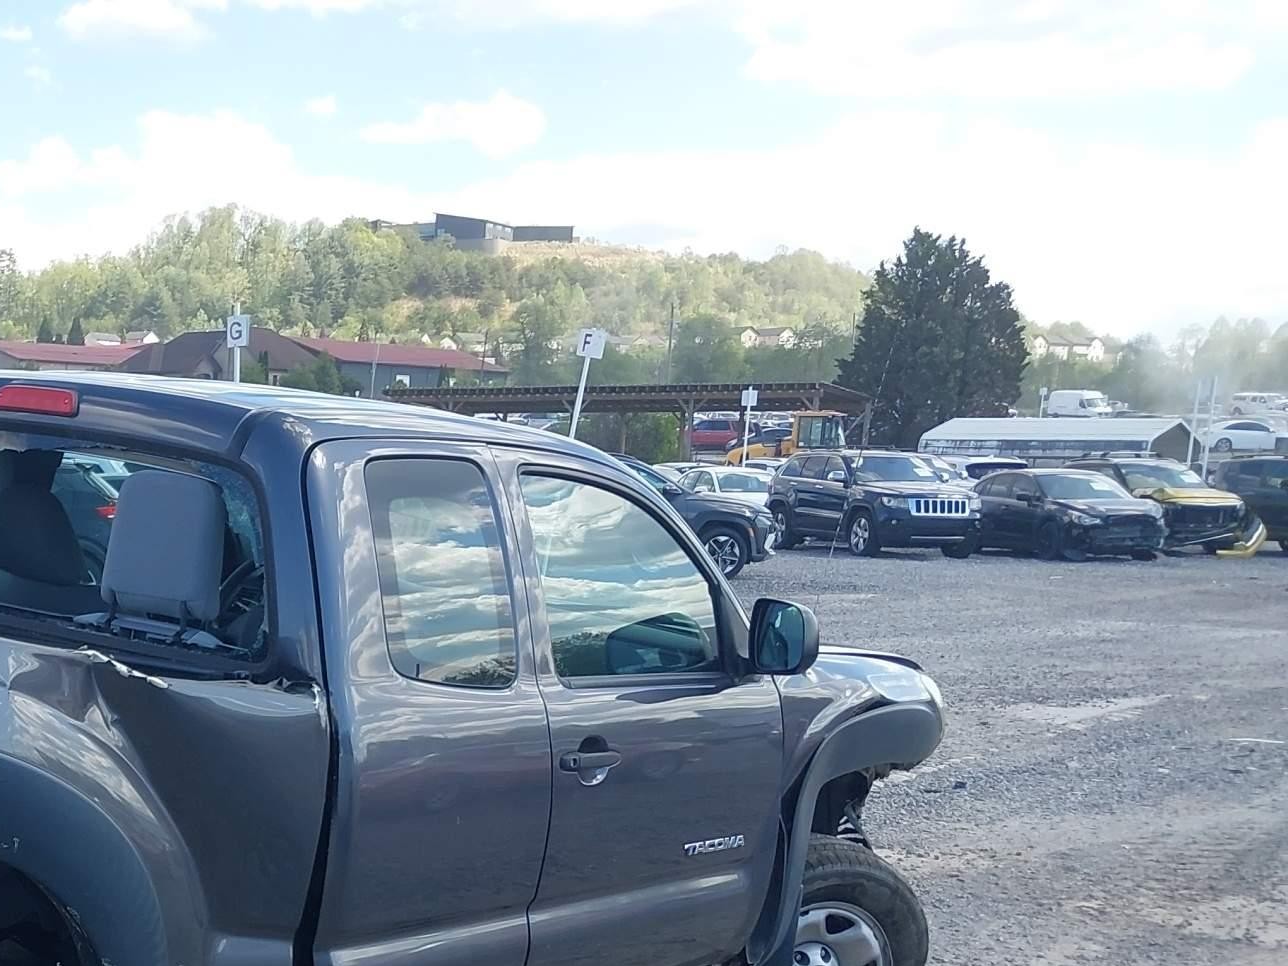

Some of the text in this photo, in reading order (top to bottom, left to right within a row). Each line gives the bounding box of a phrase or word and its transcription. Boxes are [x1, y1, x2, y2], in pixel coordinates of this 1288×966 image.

[229, 321, 243, 341] G
[582, 333, 593, 352] F
[683, 834, 745, 856] TACOMA
